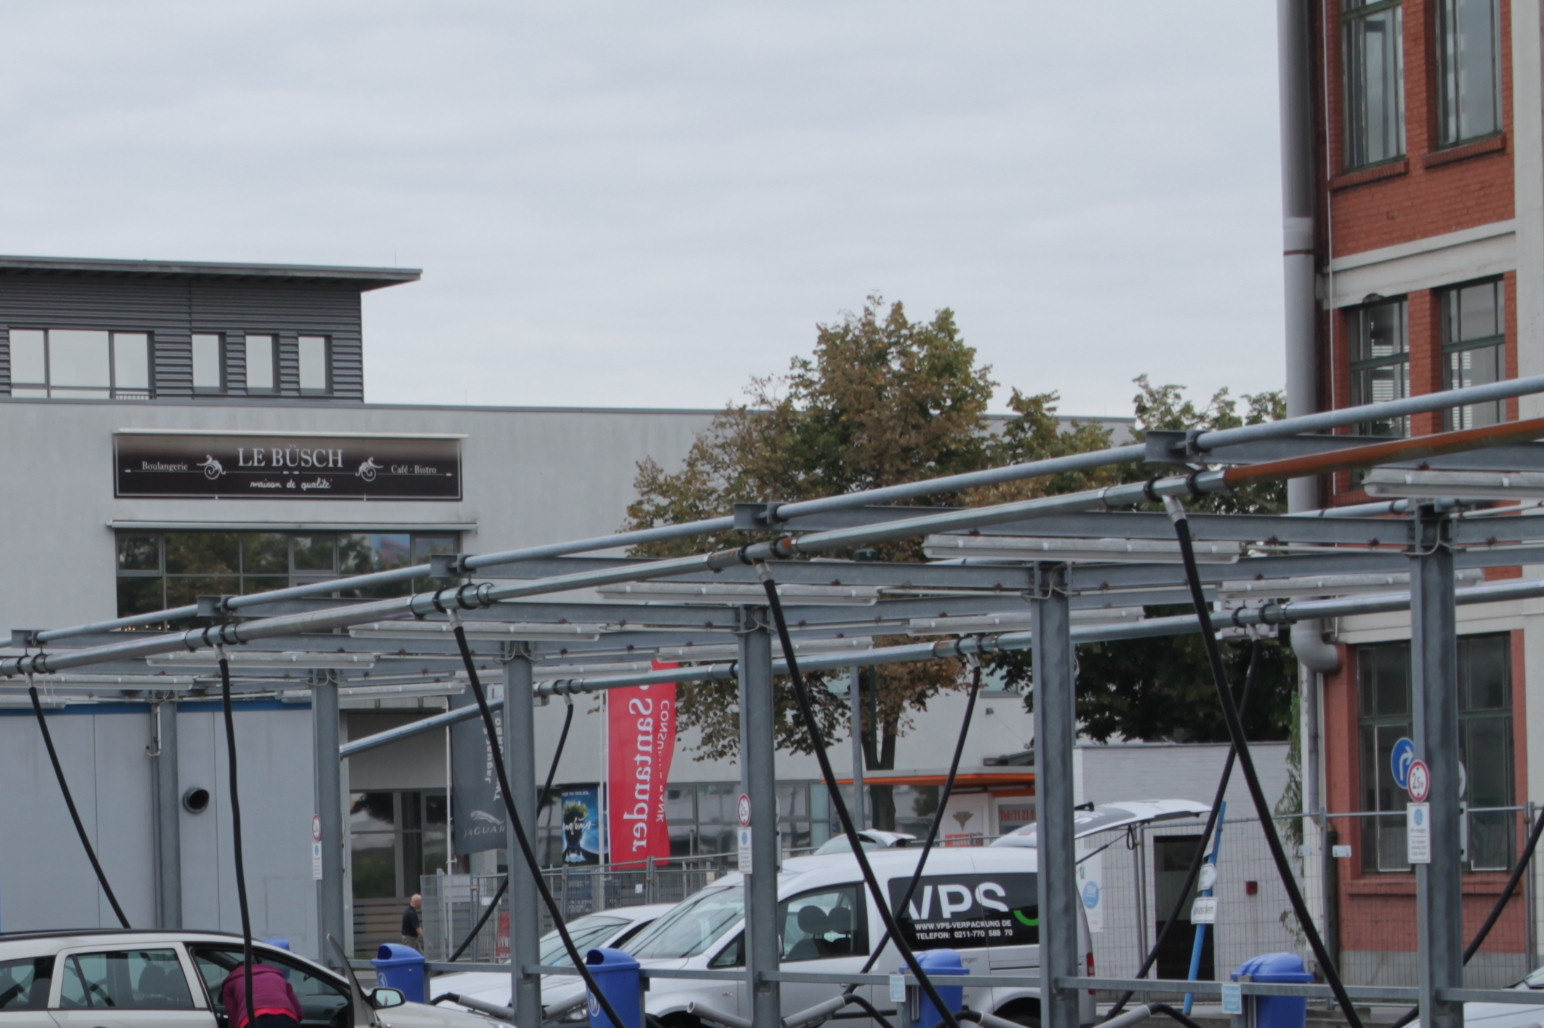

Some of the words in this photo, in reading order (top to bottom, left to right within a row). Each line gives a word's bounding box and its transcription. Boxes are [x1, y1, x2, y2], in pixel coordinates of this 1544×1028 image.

[238, 447, 266, 467] LE
[271, 444, 344, 468] BÜSCH
[142, 461, 189, 473] Boulangerie
[414, 465, 437, 475] Bistro
[286, 478, 297, 489] de
[916, 931, 951, 940] TELEFON:
